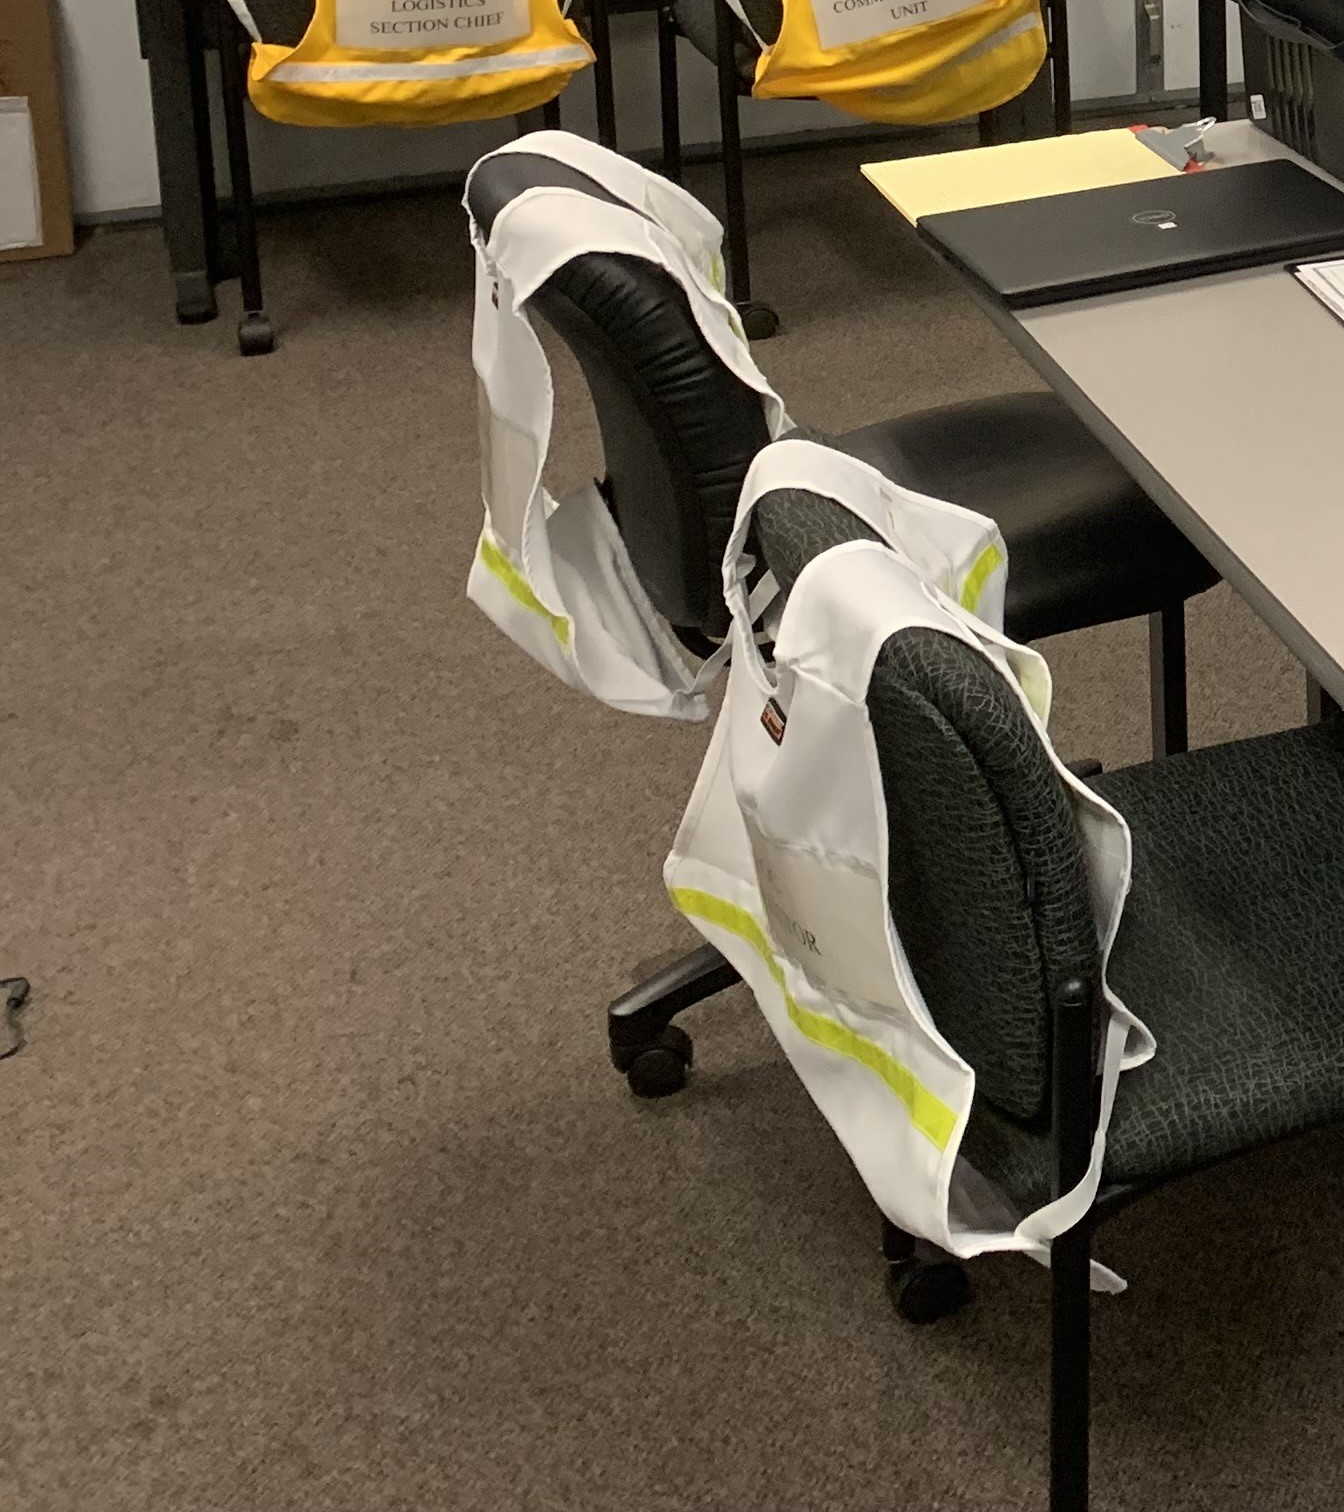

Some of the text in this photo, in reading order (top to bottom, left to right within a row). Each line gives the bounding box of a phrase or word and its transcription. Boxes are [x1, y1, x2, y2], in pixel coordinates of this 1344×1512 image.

[890, 0, 928, 20] UNIT
[370, 11, 504, 34] SECTION CHIEF
